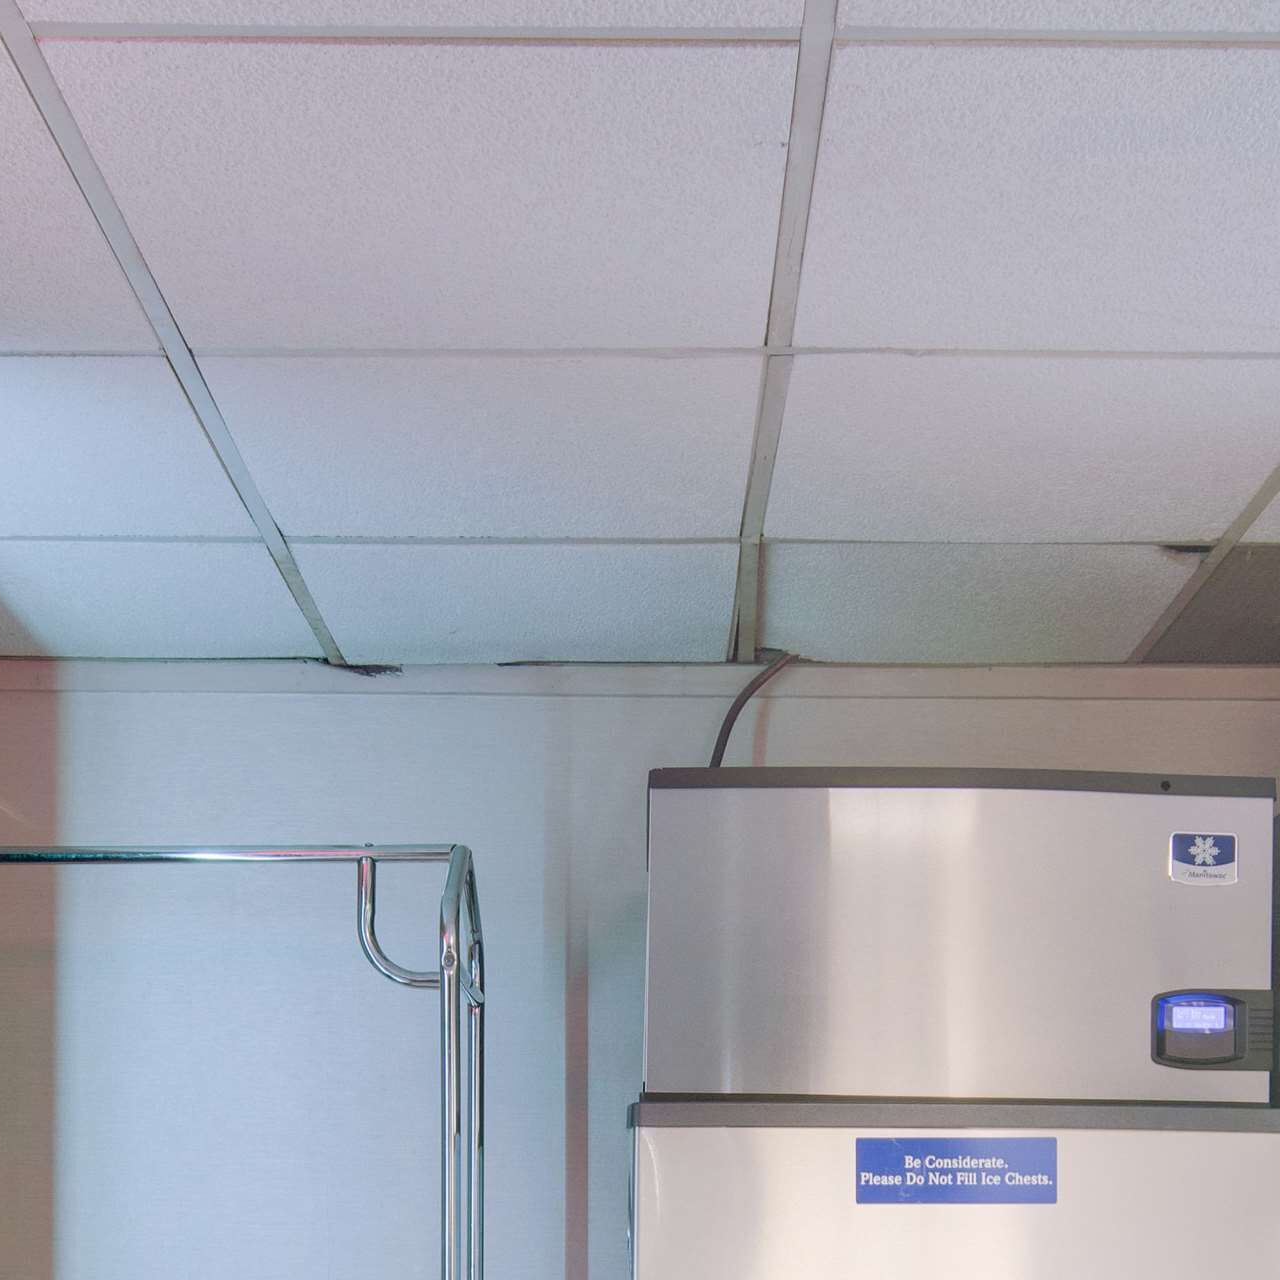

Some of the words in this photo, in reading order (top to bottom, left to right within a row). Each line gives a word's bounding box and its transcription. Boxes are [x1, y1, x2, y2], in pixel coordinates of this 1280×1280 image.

[903, 1154, 922, 1169] Be
[924, 1154, 1009, 1169] Considerate.
[859, 1171, 903, 1186] Please
[905, 1171, 926, 1186] Do
[927, 1171, 953, 1186] Not
[955, 1171, 978, 1186] Fill
[980, 1171, 1002, 1186] Ice
[1004, 1171, 1054, 1186] Chests.
